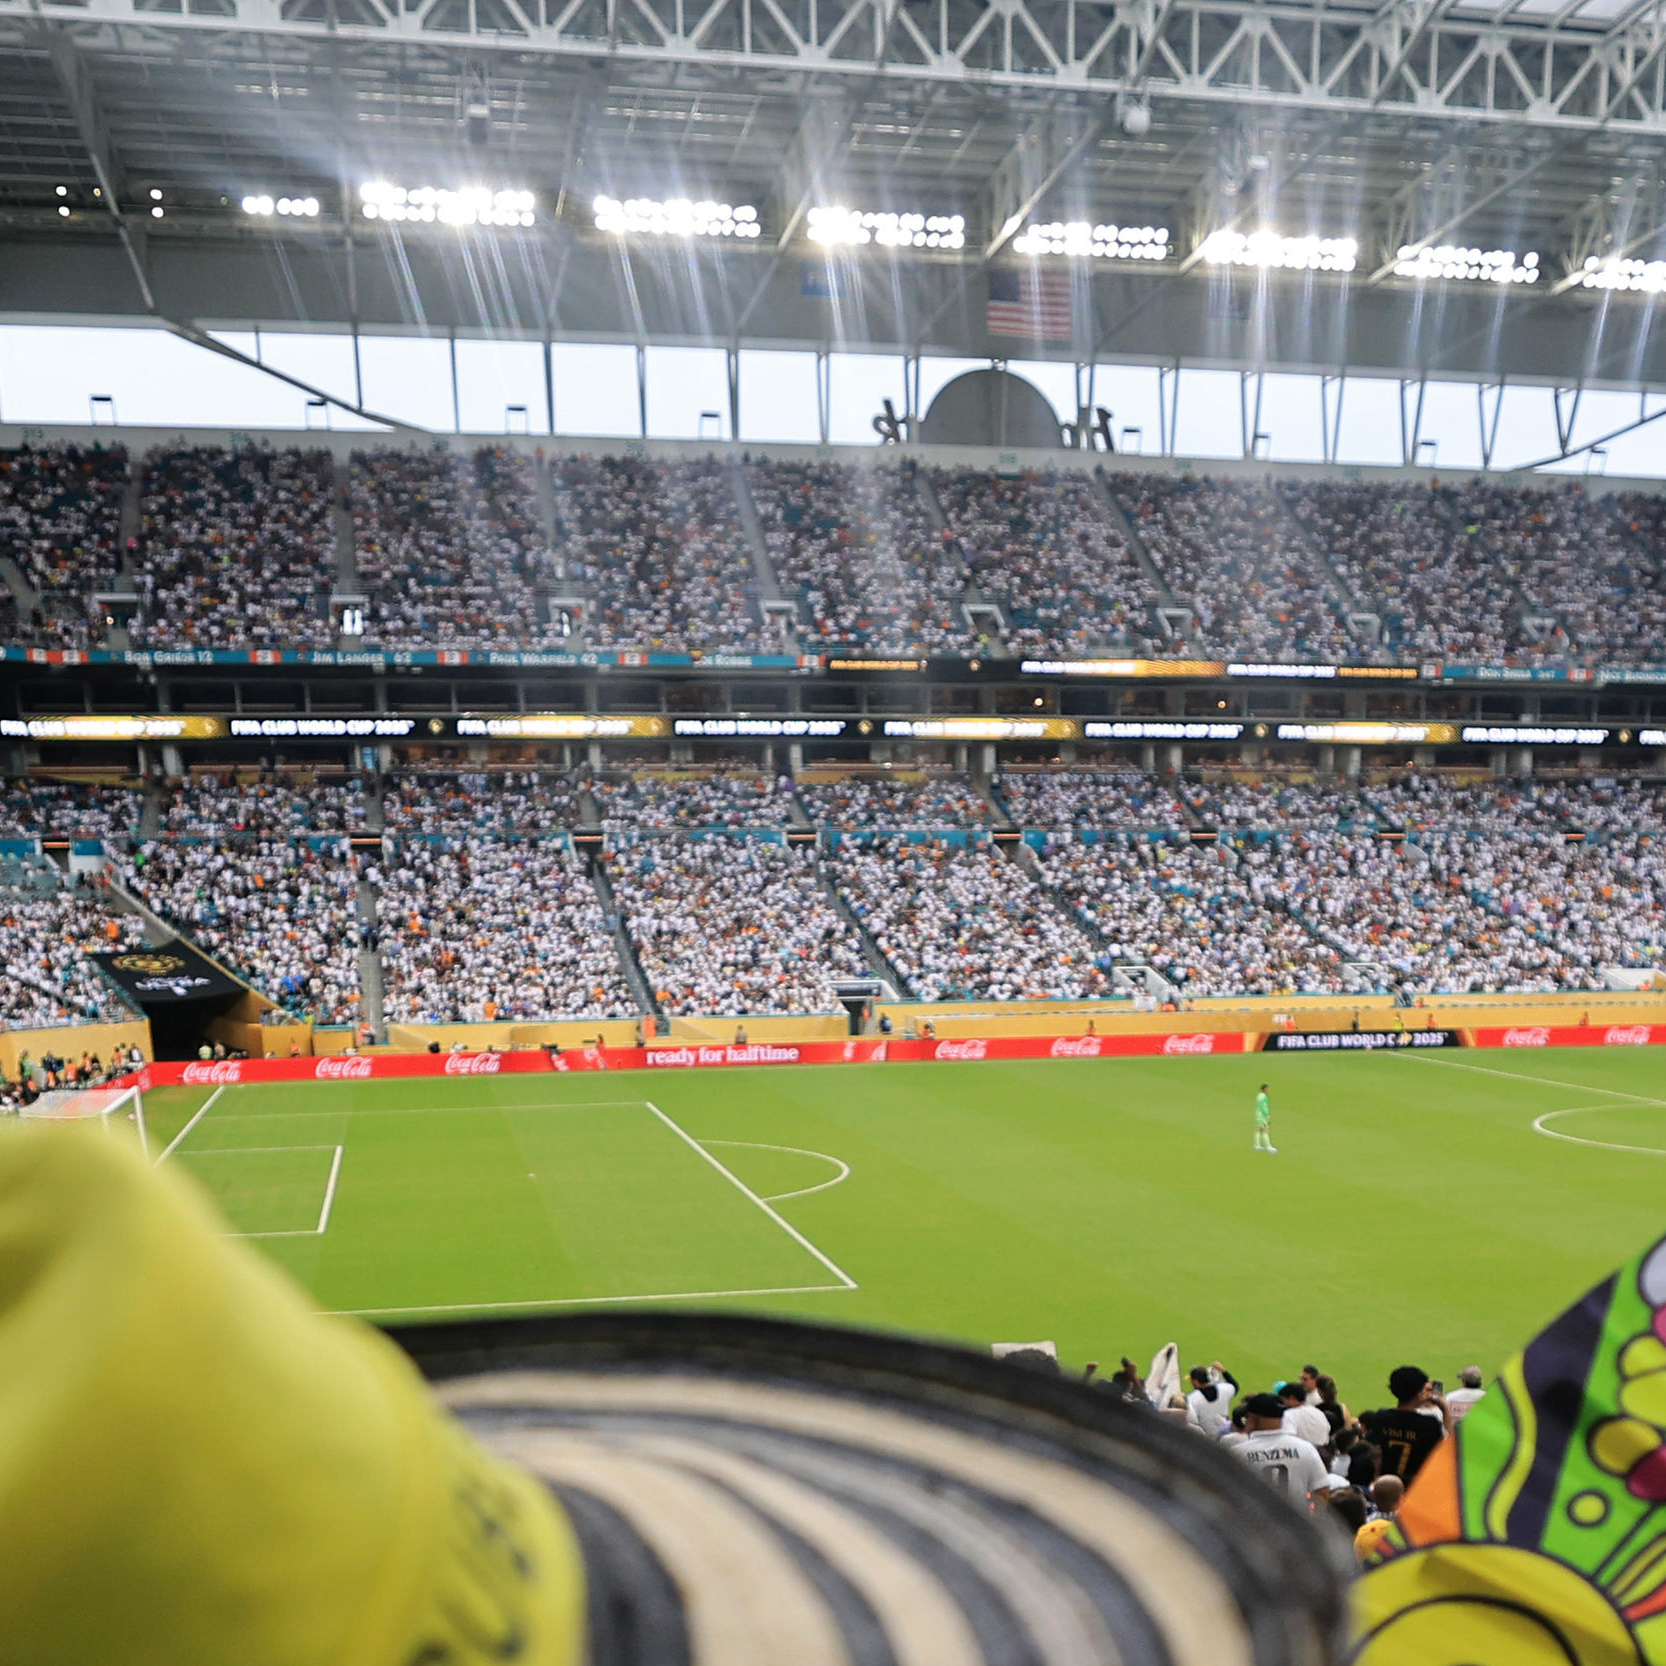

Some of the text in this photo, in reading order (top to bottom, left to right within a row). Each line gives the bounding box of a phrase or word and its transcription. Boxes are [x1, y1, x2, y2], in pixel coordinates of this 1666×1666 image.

[1276, 1033, 1306, 1050] FIFA
[1306, 1033, 1341, 1049] CLUB
[1340, 1033, 1388, 1049] WORLD
[646, 1044, 800, 1067] ready for halftime
